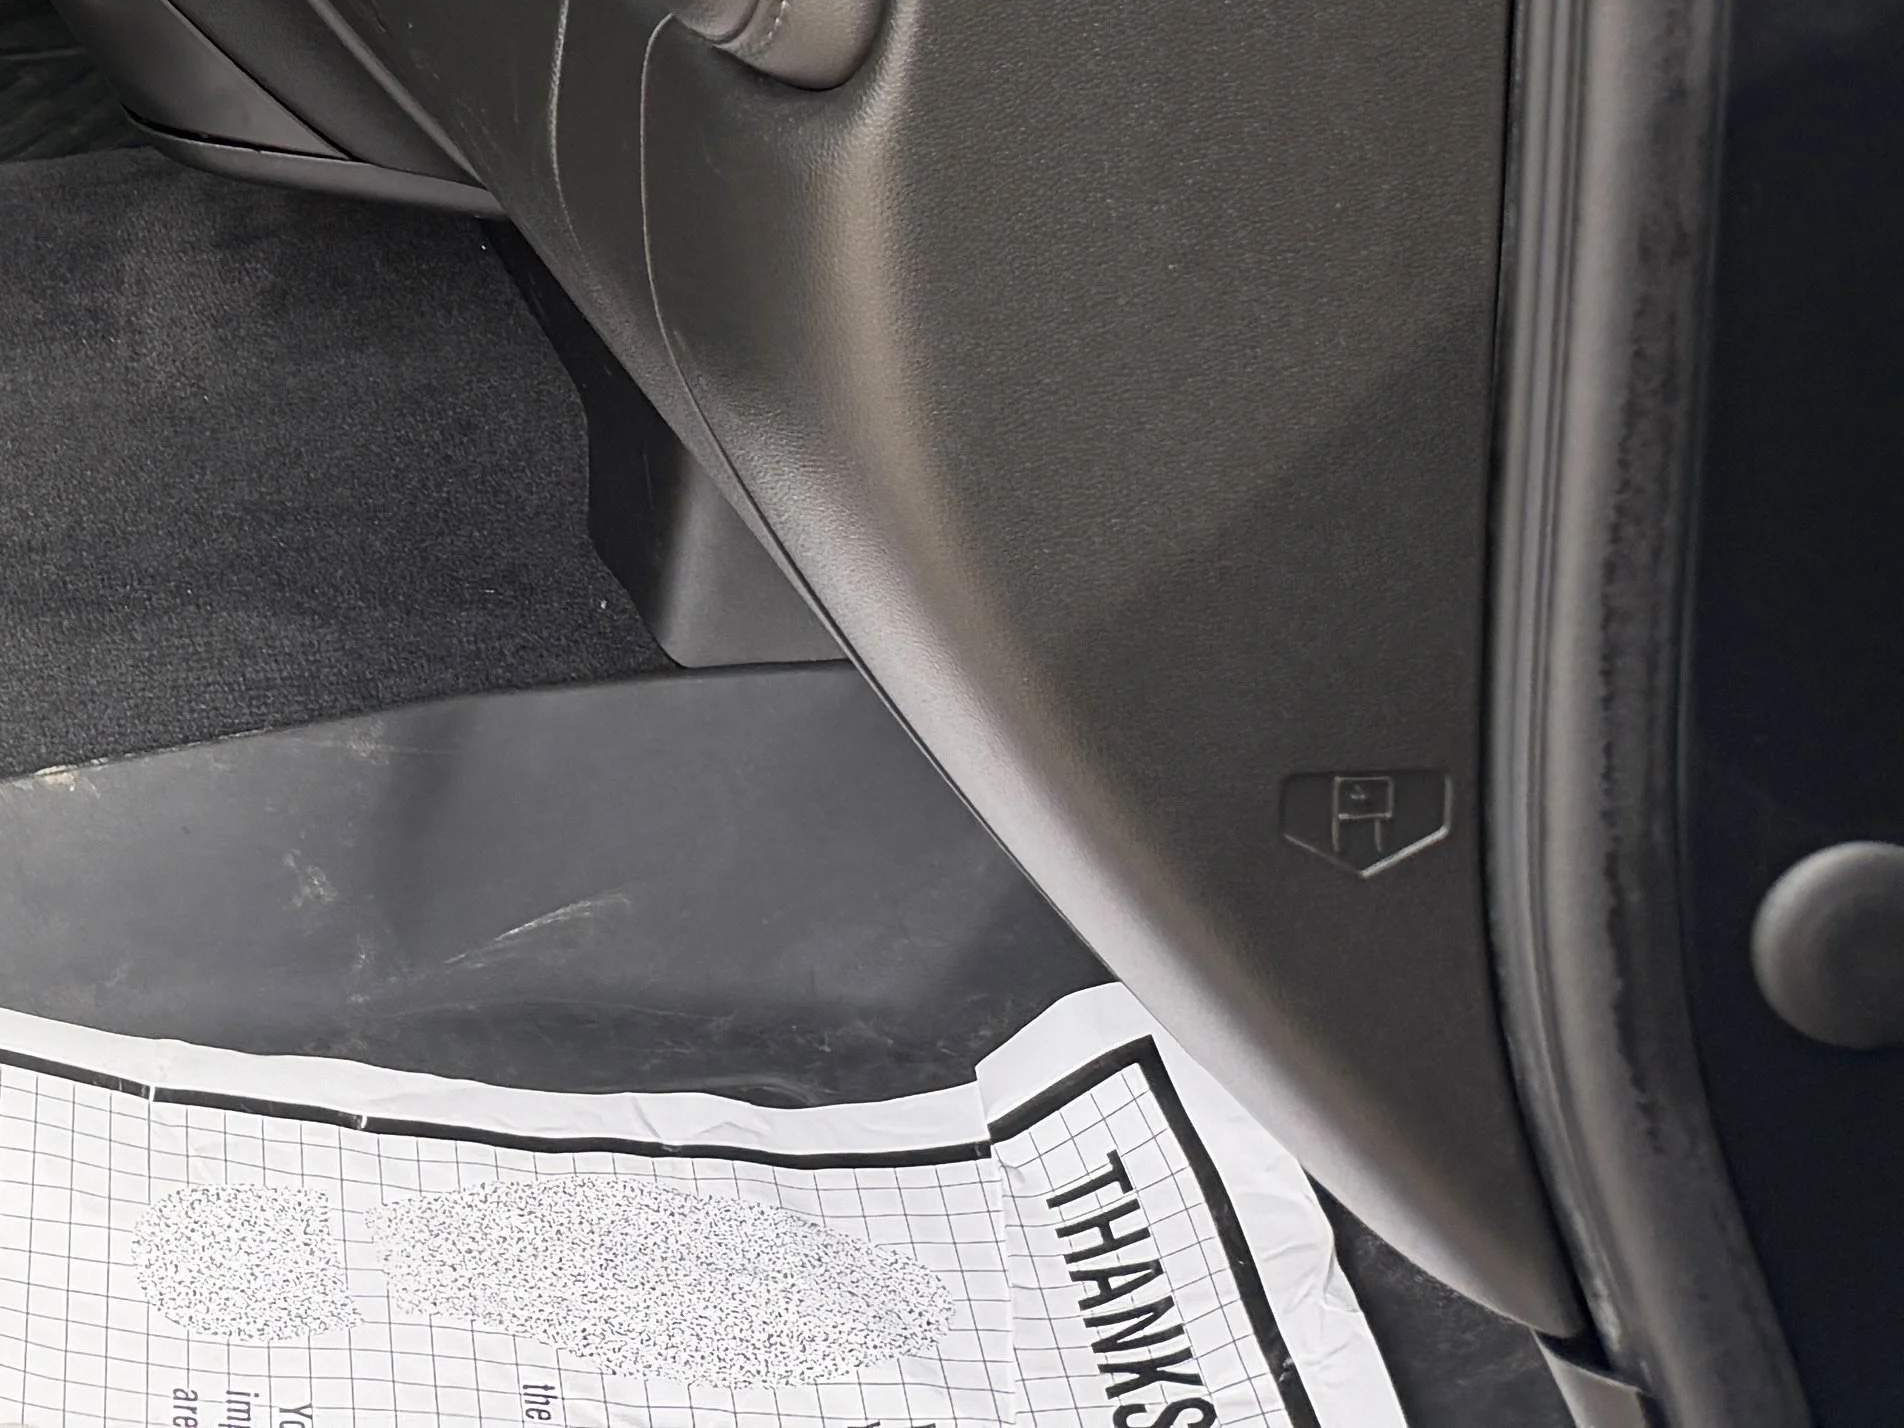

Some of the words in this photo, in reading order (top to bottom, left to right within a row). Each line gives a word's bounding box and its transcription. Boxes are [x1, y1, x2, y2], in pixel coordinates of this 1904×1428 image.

[1046, 1149, 1217, 1428] THANKS
[172, 1388, 199, 1428] are
[218, 1389, 260, 1428] im
[522, 1384, 559, 1421] the
